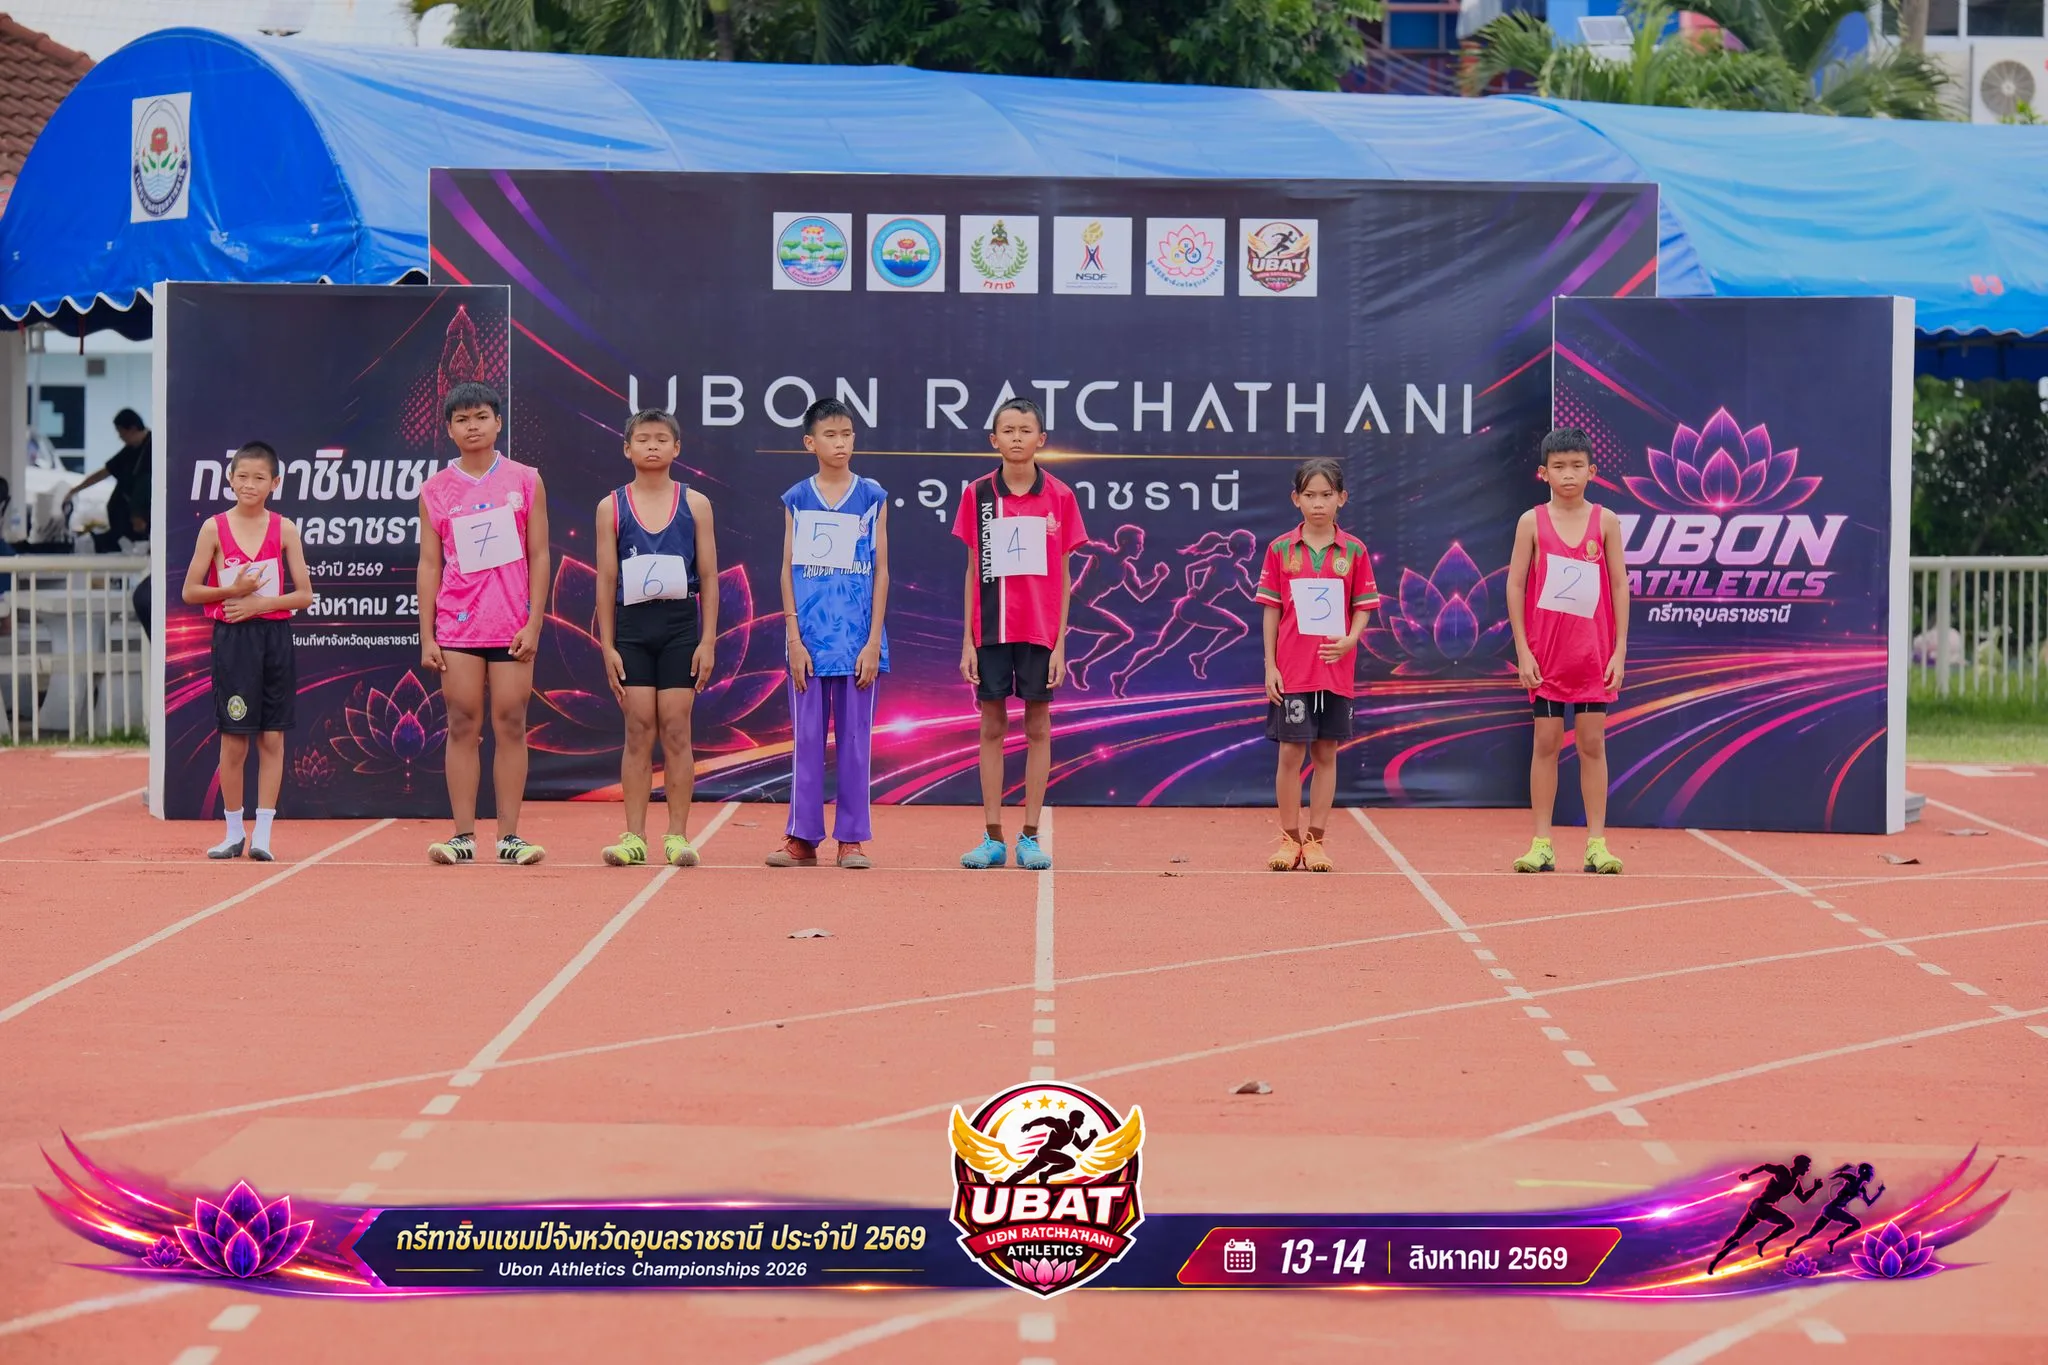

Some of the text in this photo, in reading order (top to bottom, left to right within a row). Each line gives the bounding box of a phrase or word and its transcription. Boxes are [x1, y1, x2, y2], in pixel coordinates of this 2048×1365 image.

[1075, 273, 1108, 281] NSDF
[1252, 258, 1306, 272] UBAT
[629, 374, 1472, 434] UBON RATCHATHANI
[471, 521, 499, 558] 7
[811, 522, 840, 559] 5
[1007, 527, 1027, 562] 4
[1621, 513, 1849, 566] UBON
[347, 562, 384, 577] 2569
[643, 560, 664, 598] 6
[1554, 565, 1582, 601] 2
[1628, 570, 1838, 597] ATHLETICS
[395, 595, 419, 616] 25
[1308, 586, 1332, 621] 3
